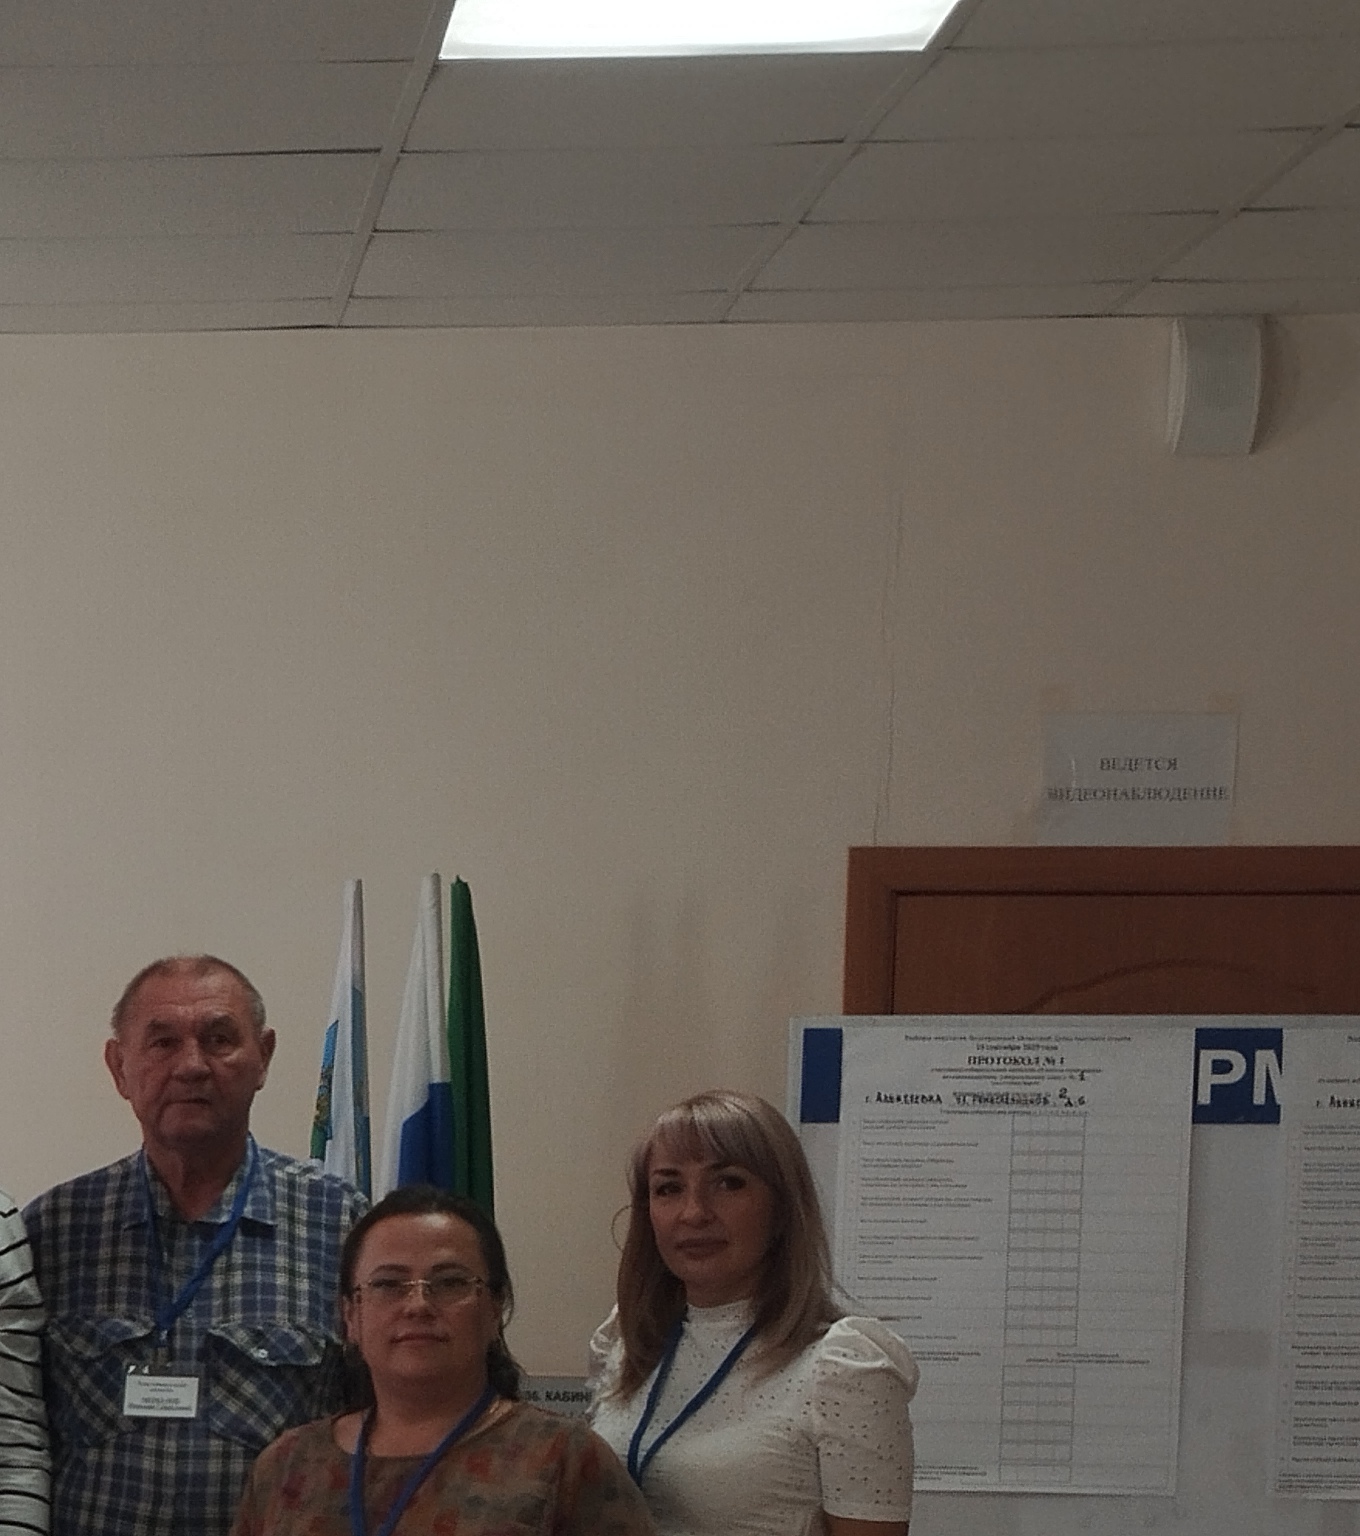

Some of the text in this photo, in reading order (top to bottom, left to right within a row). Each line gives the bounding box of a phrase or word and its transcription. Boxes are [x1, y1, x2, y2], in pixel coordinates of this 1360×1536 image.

[1100, 757, 1178, 772] ВЕДЕТСЯ
[1047, 786, 1228, 802] ВИДЕОНАБЛЮДЕНИЕ
[967, 1056, 1040, 1066] ПРОТОКОЛ
